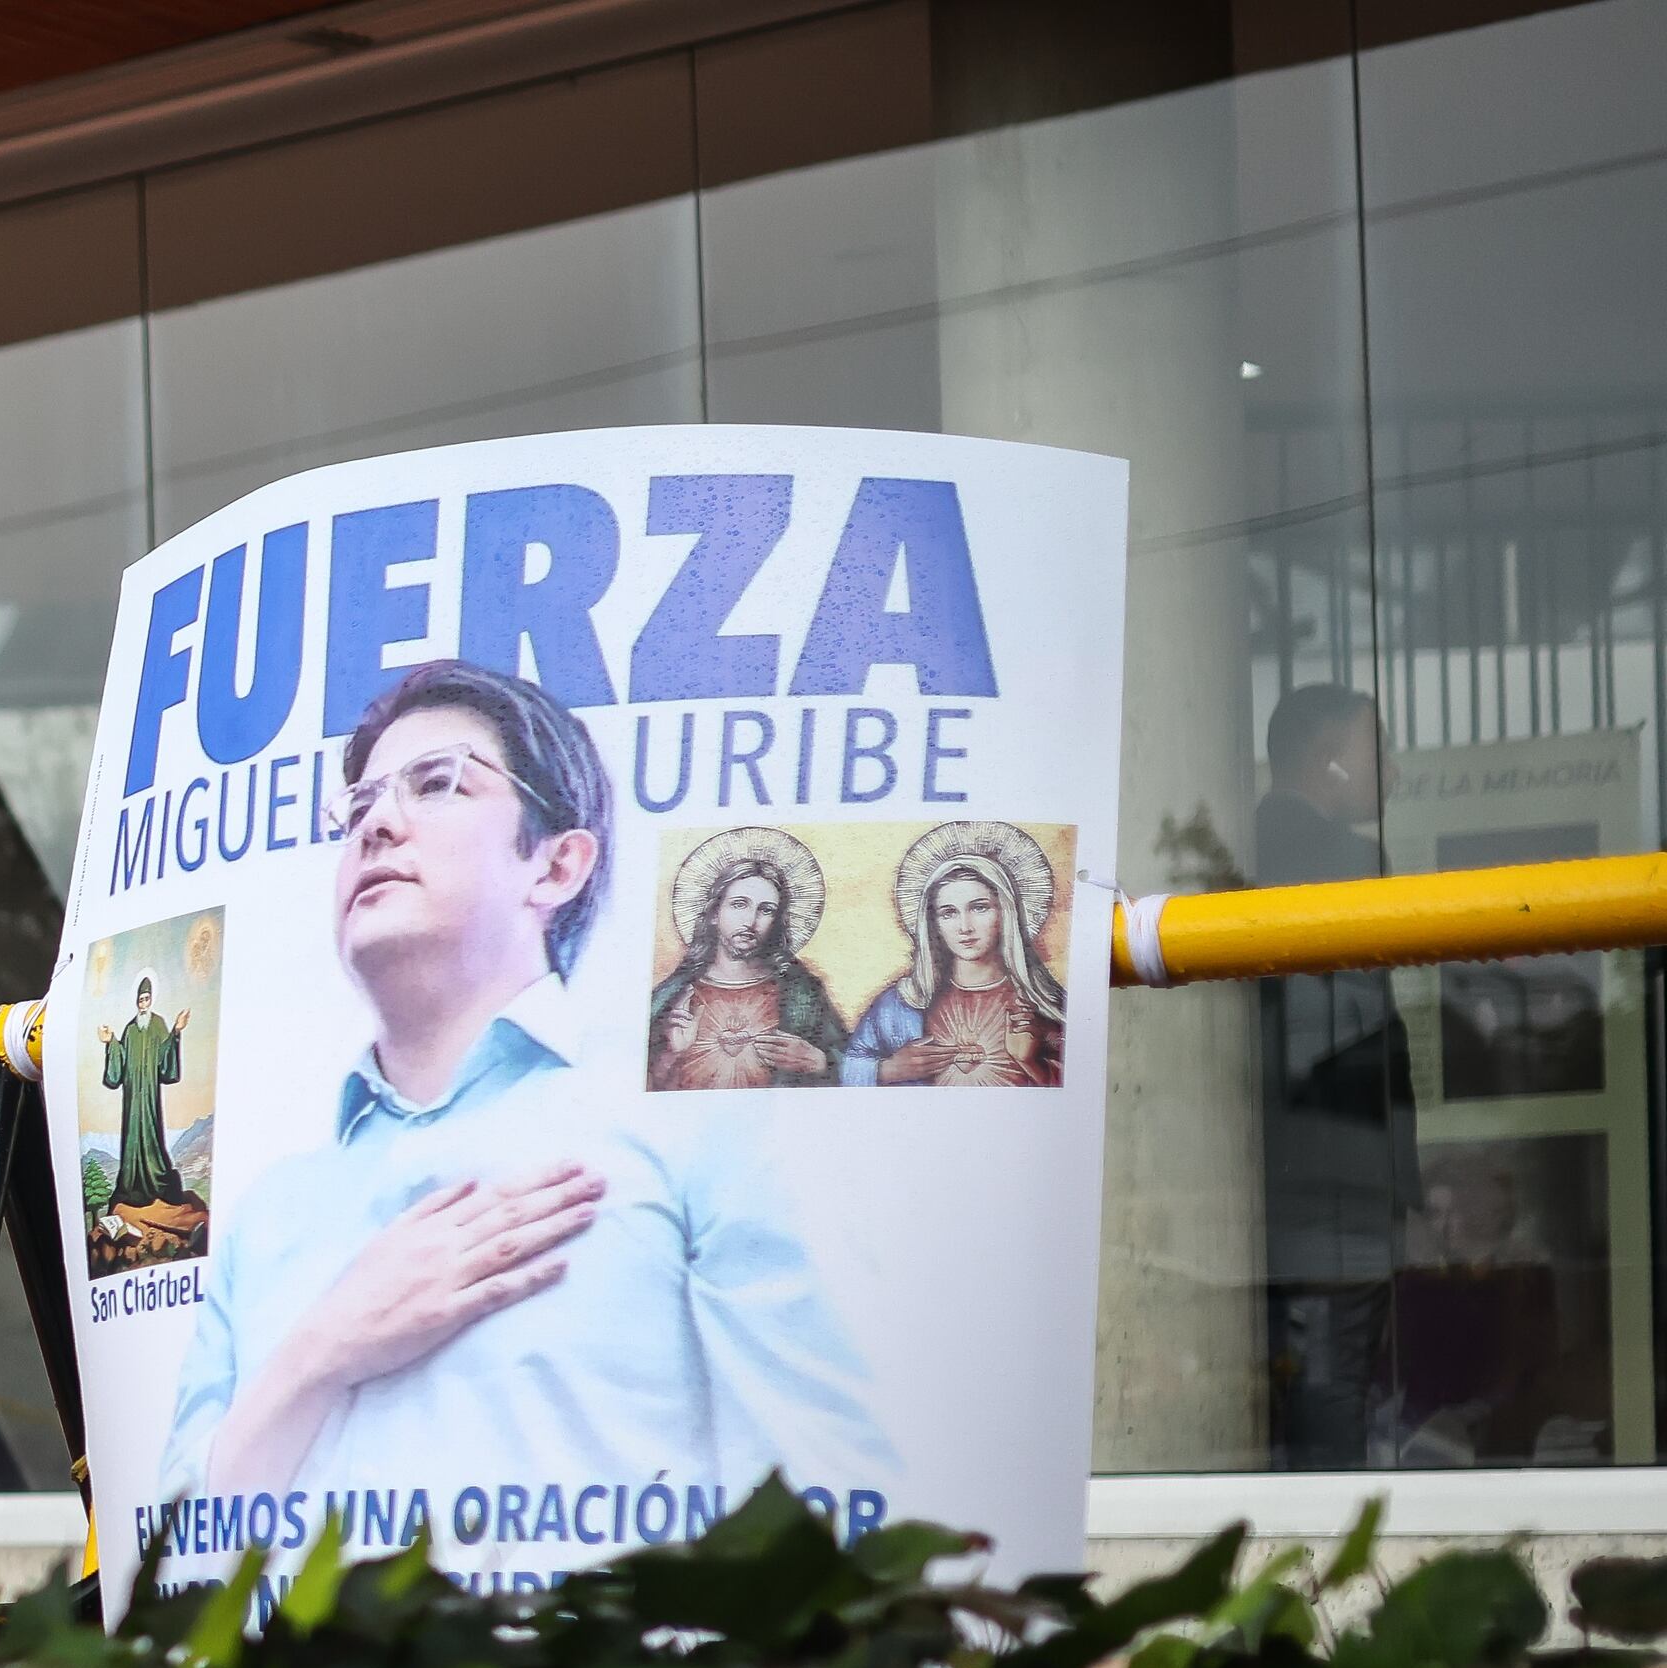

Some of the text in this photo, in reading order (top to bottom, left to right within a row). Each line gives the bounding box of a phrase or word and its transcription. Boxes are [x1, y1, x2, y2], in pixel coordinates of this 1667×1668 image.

[123, 474, 1000, 801] FUERZA
[110, 738, 346, 896] MIGUEL
[633, 707, 973, 813] URIBE
[1482, 758, 1622, 792] MEMORIA
[91, 1287, 117, 1323] San
[135, 1491, 310, 1561] ELEVEMOS
[326, 1489, 431, 1548] UNA
[454, 1469, 727, 1546] ORACIÓN
